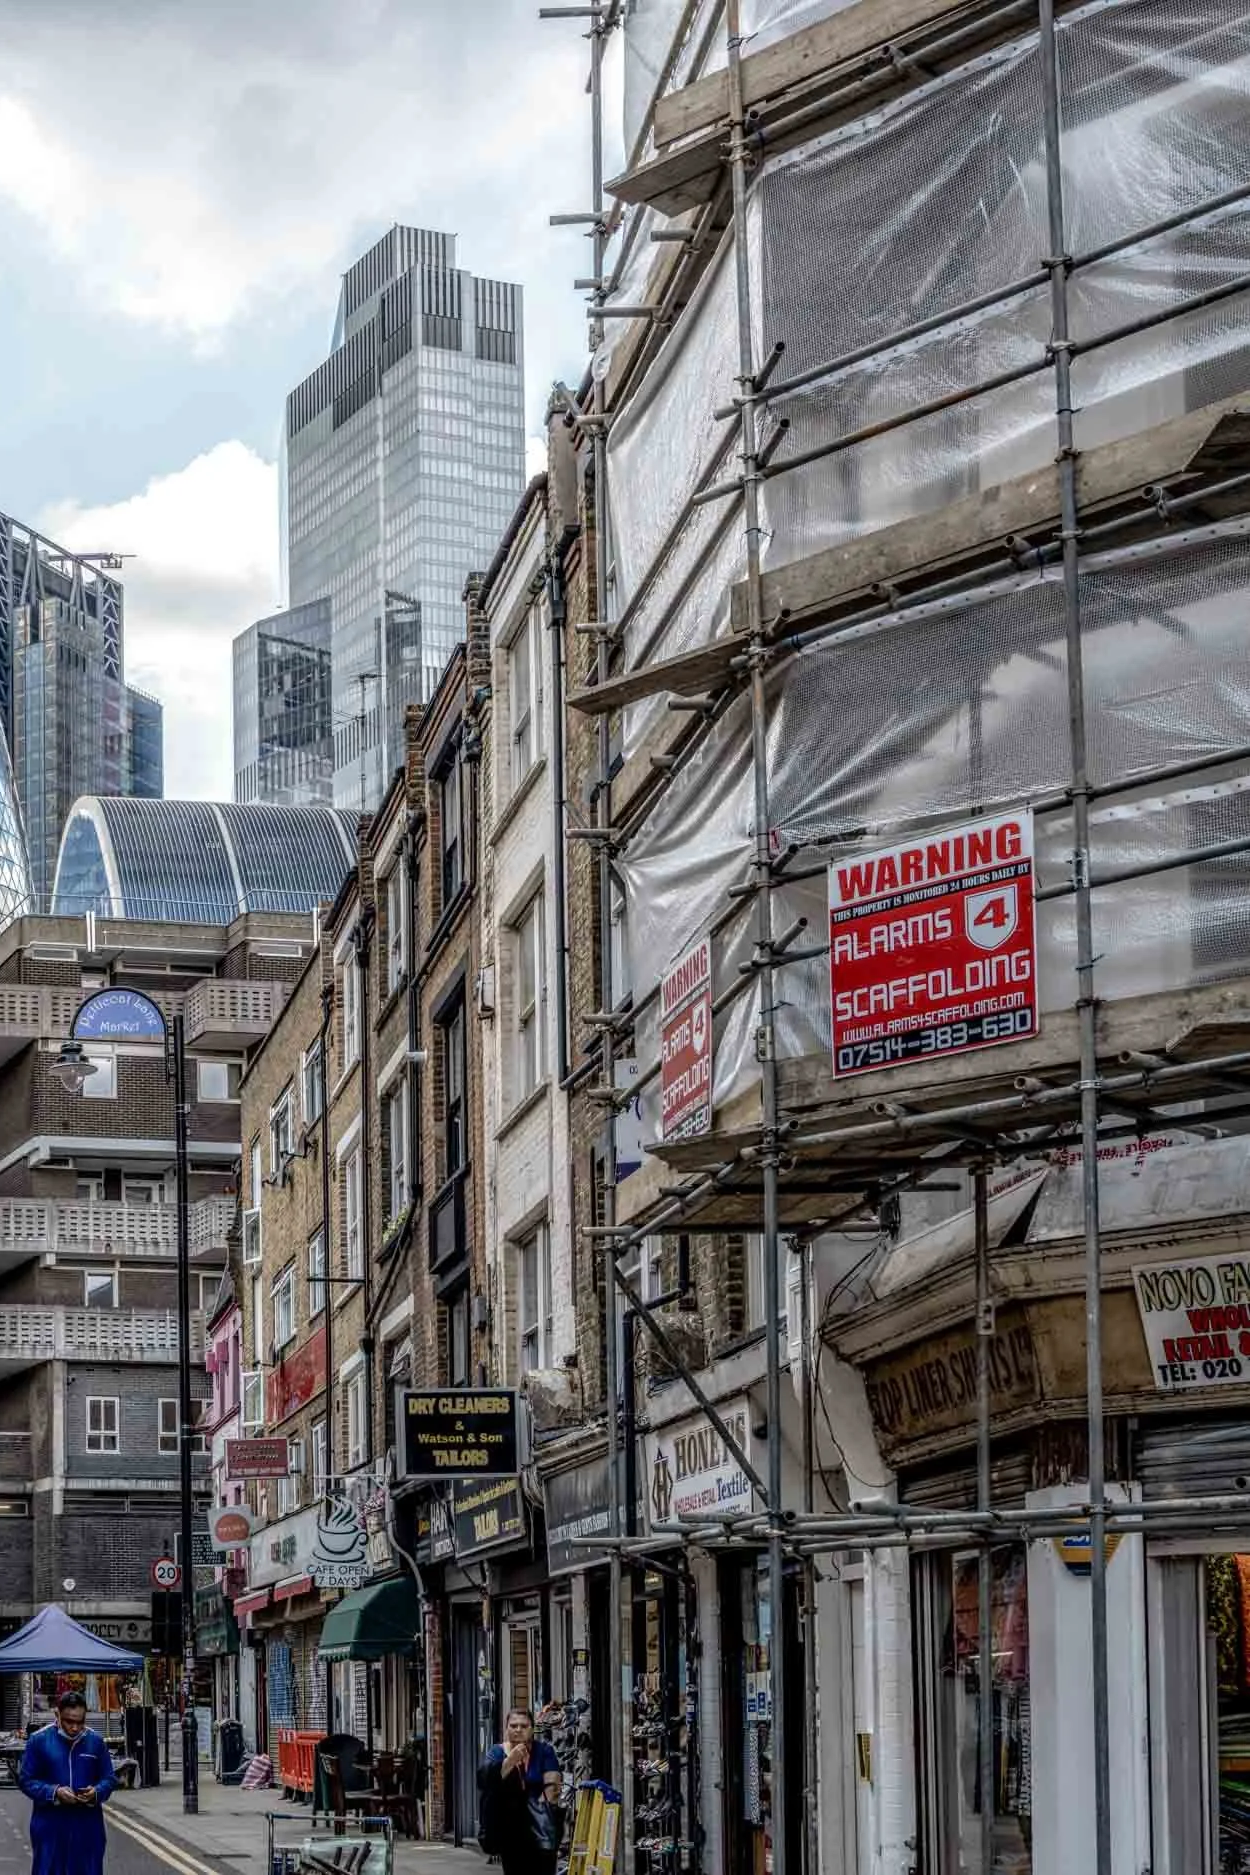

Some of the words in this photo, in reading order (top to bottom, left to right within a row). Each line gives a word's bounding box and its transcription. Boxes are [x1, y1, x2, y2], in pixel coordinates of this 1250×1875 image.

[837, 822, 1023, 902] WARNING
[833, 907, 851, 923] THIS
[853, 899, 891, 917] PROPERTY
[893, 895, 902, 906] IS
[950, 882, 960, 893] 24
[962, 874, 990, 890] HOURS
[992, 867, 1016, 884] DAILY
[1018, 862, 1030, 876] BY
[973, 896, 1010, 929] 4
[834, 907, 952, 965] ALARMS
[662, 944, 708, 1012] WARNING
[836, 949, 1031, 1022] SCAFFOLDING
[100, 1021, 140, 1033] Market
[695, 1008, 704, 1032] 4
[662, 1019, 690, 1065] ALARMS
[838, 1007, 1032, 1071] 07514-383-630
[663, 1055, 710, 1115] SCAFFOLDING
[1139, 1266, 1215, 1313] NOVO
[1217, 1261, 1250, 1304] FA
[1157, 1363, 1197, 1385] TEL:
[1202, 1358, 1242, 1379] 020
[408, 1397, 436, 1415] DRY
[438, 1396, 511, 1415] CLEANERS
[418, 1433, 463, 1444] Watson
[467, 1432, 477, 1444] &
[479, 1432, 503, 1443] Son
[454, 1420, 465, 1431] &
[432, 1449, 489, 1467] TAILORS
[716, 1471, 750, 1502] Textile
[157, 1566, 176, 1579] 20
[307, 1564, 335, 1575] CAFE
[338, 1565, 369, 1575] OPEN
[318, 1576, 325, 1586] 7
[330, 1576, 357, 1586] DAYS
